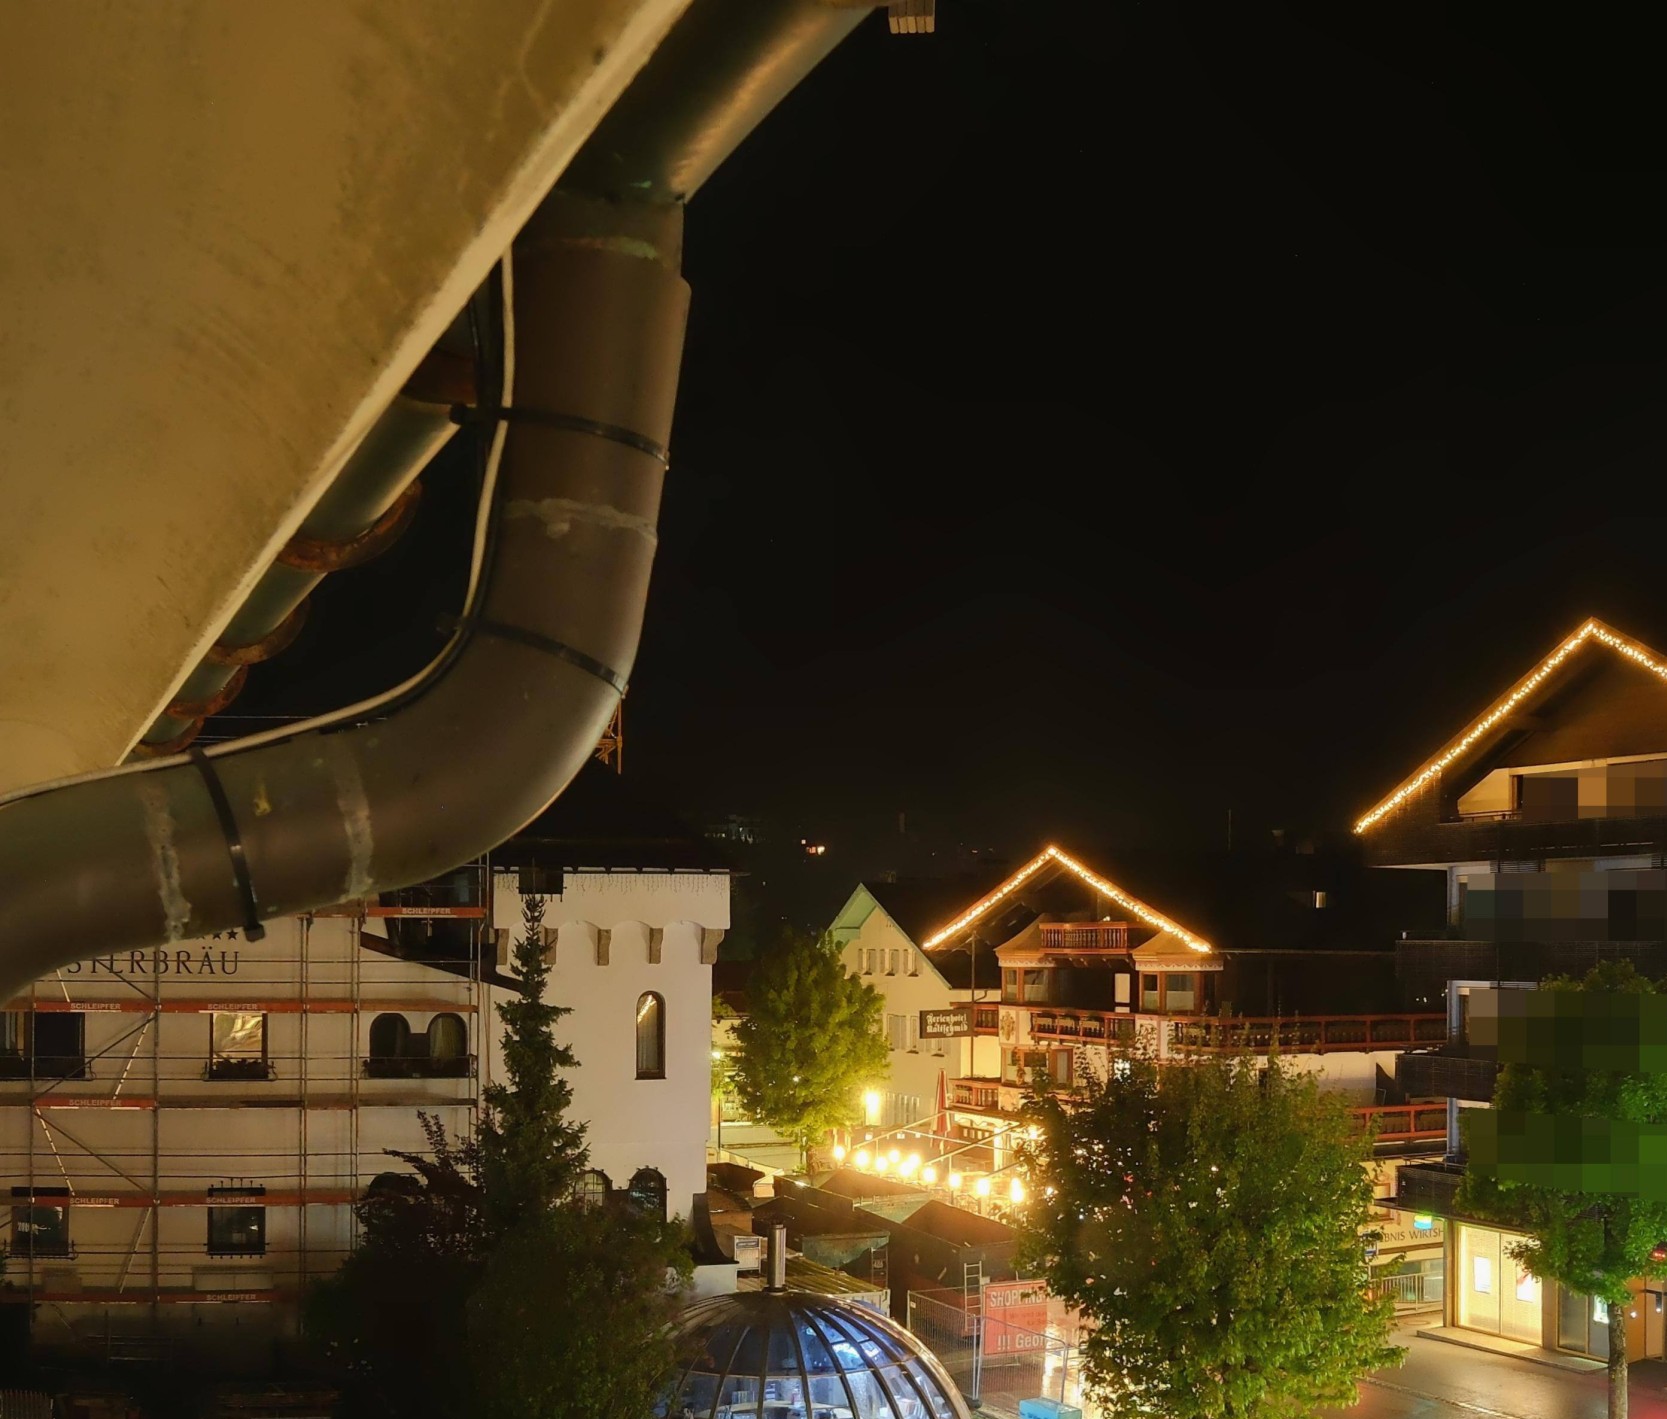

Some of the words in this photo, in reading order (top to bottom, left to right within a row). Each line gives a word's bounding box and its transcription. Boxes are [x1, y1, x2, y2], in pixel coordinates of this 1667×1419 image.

[401, 906, 452, 916] SCHLEIPFER
[67, 945, 240, 976] STERBRÄU
[70, 1002, 121, 1011] SCHLEIPFER
